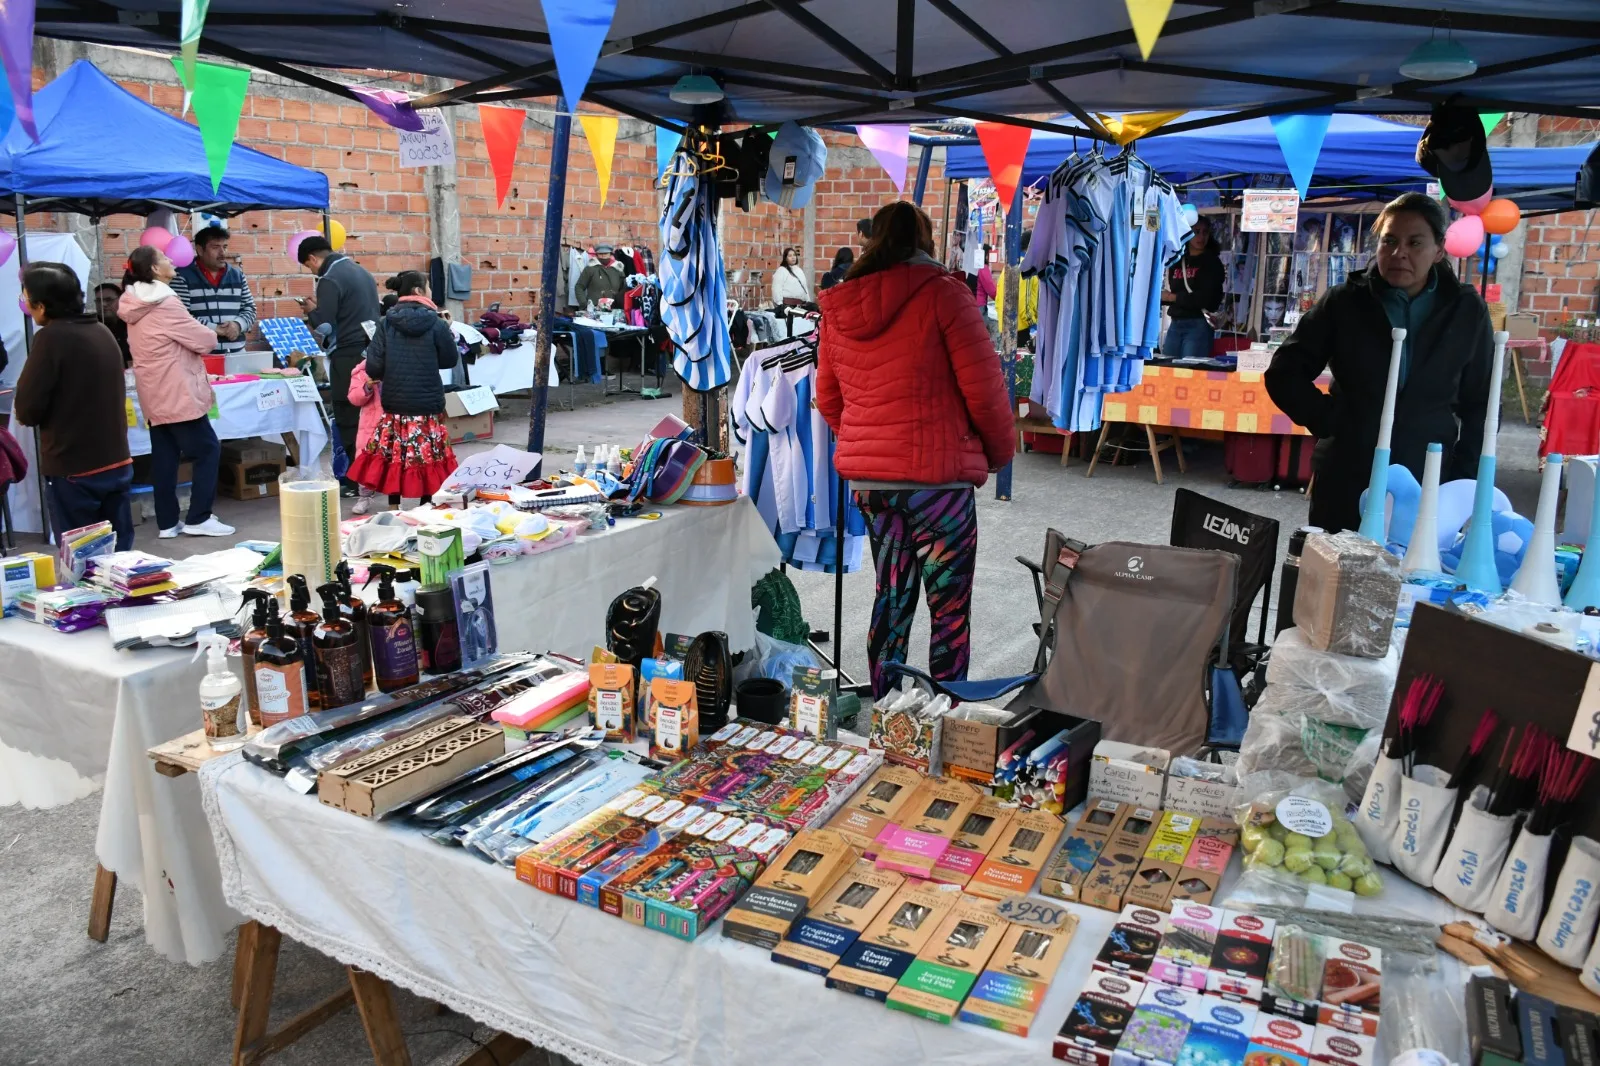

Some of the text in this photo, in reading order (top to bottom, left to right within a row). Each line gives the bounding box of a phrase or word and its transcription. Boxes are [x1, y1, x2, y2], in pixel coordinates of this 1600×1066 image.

[1113, 571, 1155, 581] ALPHA CAMP
[950, 719, 980, 733] Romero
[1104, 766, 1137, 781] Canela
[1190, 785, 1225, 798] poderes
[904, 836, 929, 846] Berry
[1198, 838, 1227, 849] ROSE
[983, 871, 1023, 884] Pimienta
[988, 867, 1023, 879] Naranja
[745, 897, 767, 906] Flores
[767, 901, 794, 913] Blancas
[750, 892, 797, 908] Gardenias
[1235, 918, 1262, 928] DARSHAN
[800, 930, 838, 945] Oriental
[801, 925, 845, 942] Fragancia
[863, 949, 893, 962] Ébano
[1341, 946, 1368, 956] DARSHAN
[859, 955, 891, 968] Marfil
[917, 976, 933, 985] del
[1102, 979, 1129, 990] DARSHAN
[989, 979, 1034, 996] Variedad
[1214, 1009, 1243, 1022] DARSHAN
[1219, 1029, 1240, 1040] WATER
[1270, 1024, 1299, 1036] DARSHAN
[1329, 1040, 1359, 1052] DARSHAN
